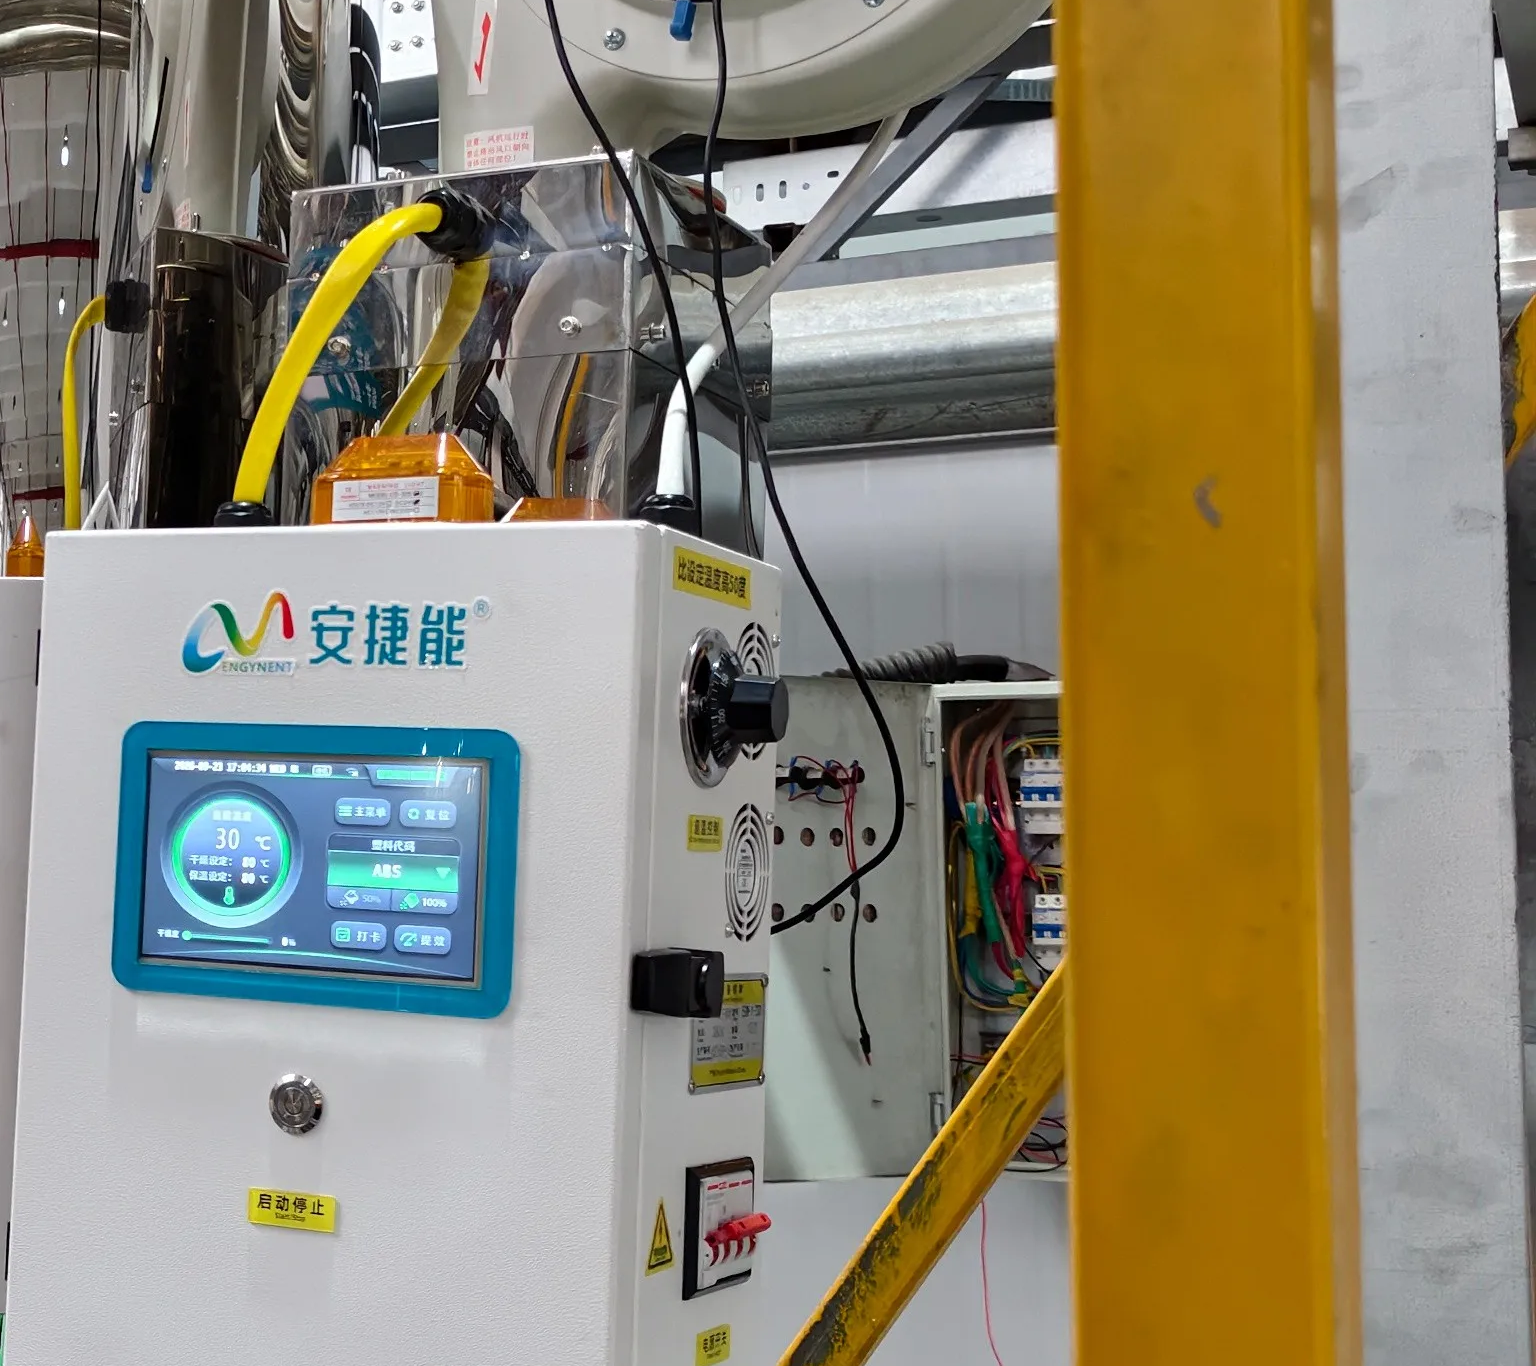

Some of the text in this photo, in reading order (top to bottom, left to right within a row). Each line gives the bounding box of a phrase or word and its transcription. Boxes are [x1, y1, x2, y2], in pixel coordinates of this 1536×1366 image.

[309, 604, 467, 666] 安捷能
[215, 828, 240, 850] 30
[371, 863, 403, 879] ABS
[422, 897, 448, 908] 100%
[356, 931, 382, 943] 打卡
[257, 1193, 325, 1216] 启动停止
